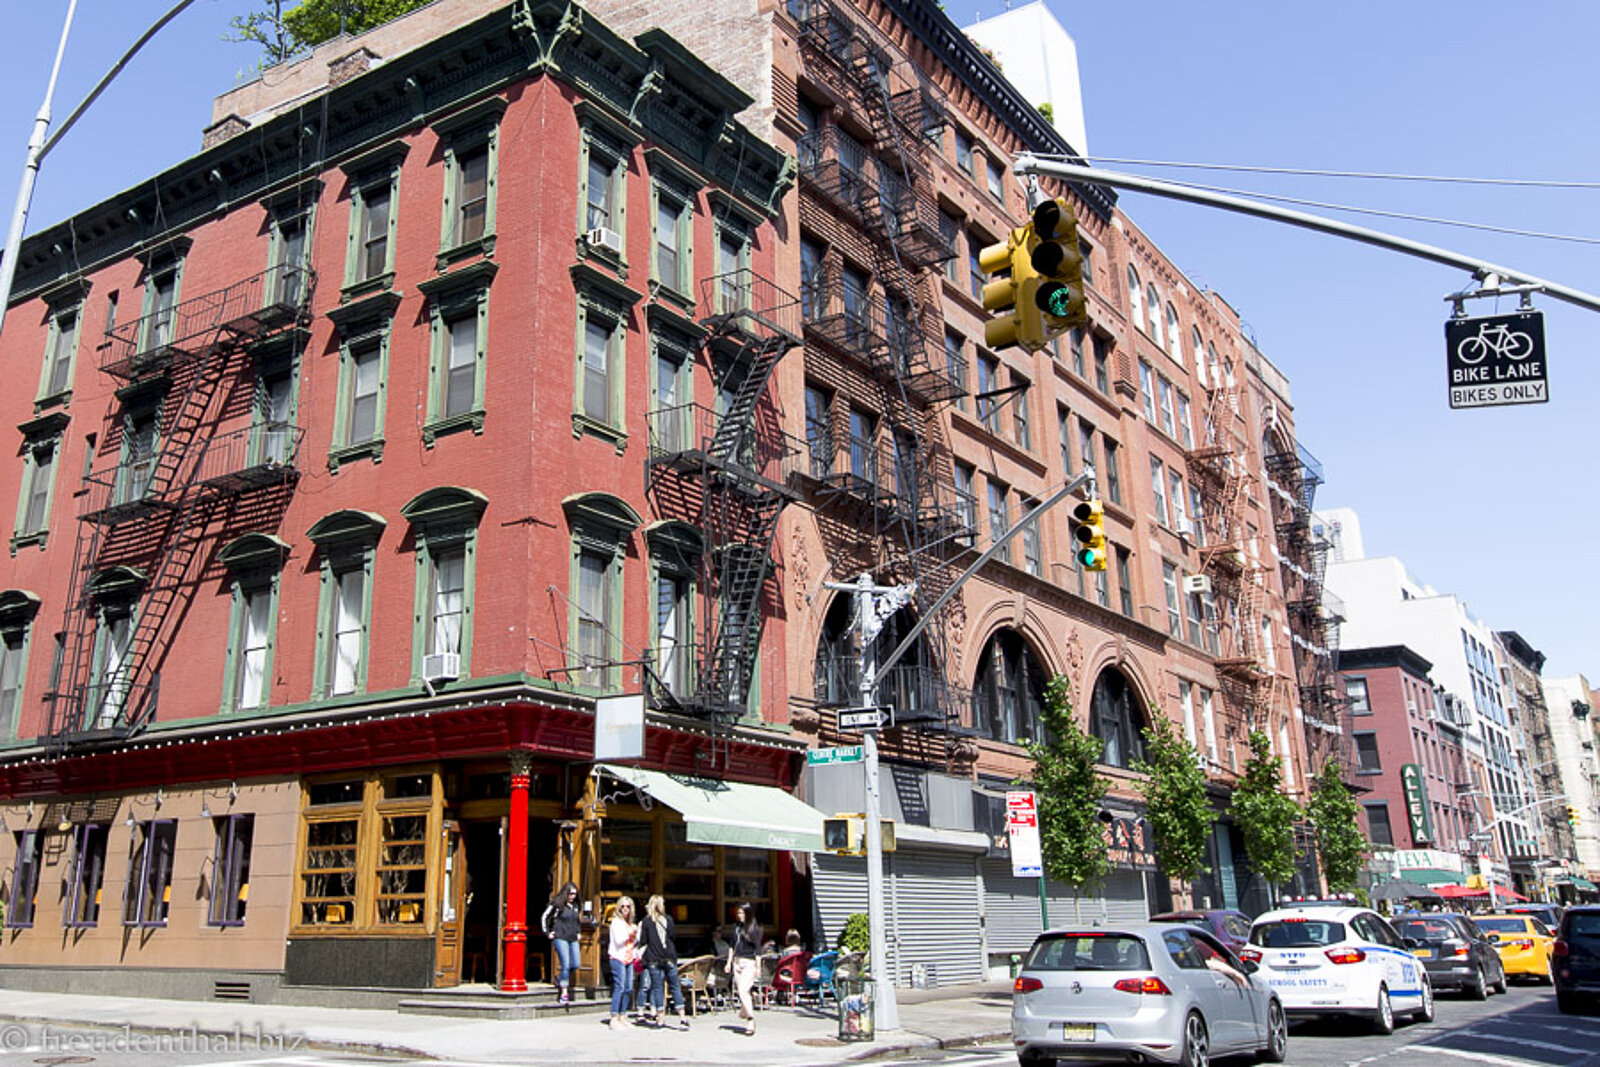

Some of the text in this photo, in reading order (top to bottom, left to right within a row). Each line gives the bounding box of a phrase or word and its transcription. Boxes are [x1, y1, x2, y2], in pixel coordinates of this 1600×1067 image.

[1453, 362, 1541, 382] BIKE LANE
[1453, 384, 1543, 403] BIKES ONLY
[1404, 765, 1427, 841] ALLEVA
[1381, 851, 1433, 867] LEVA
